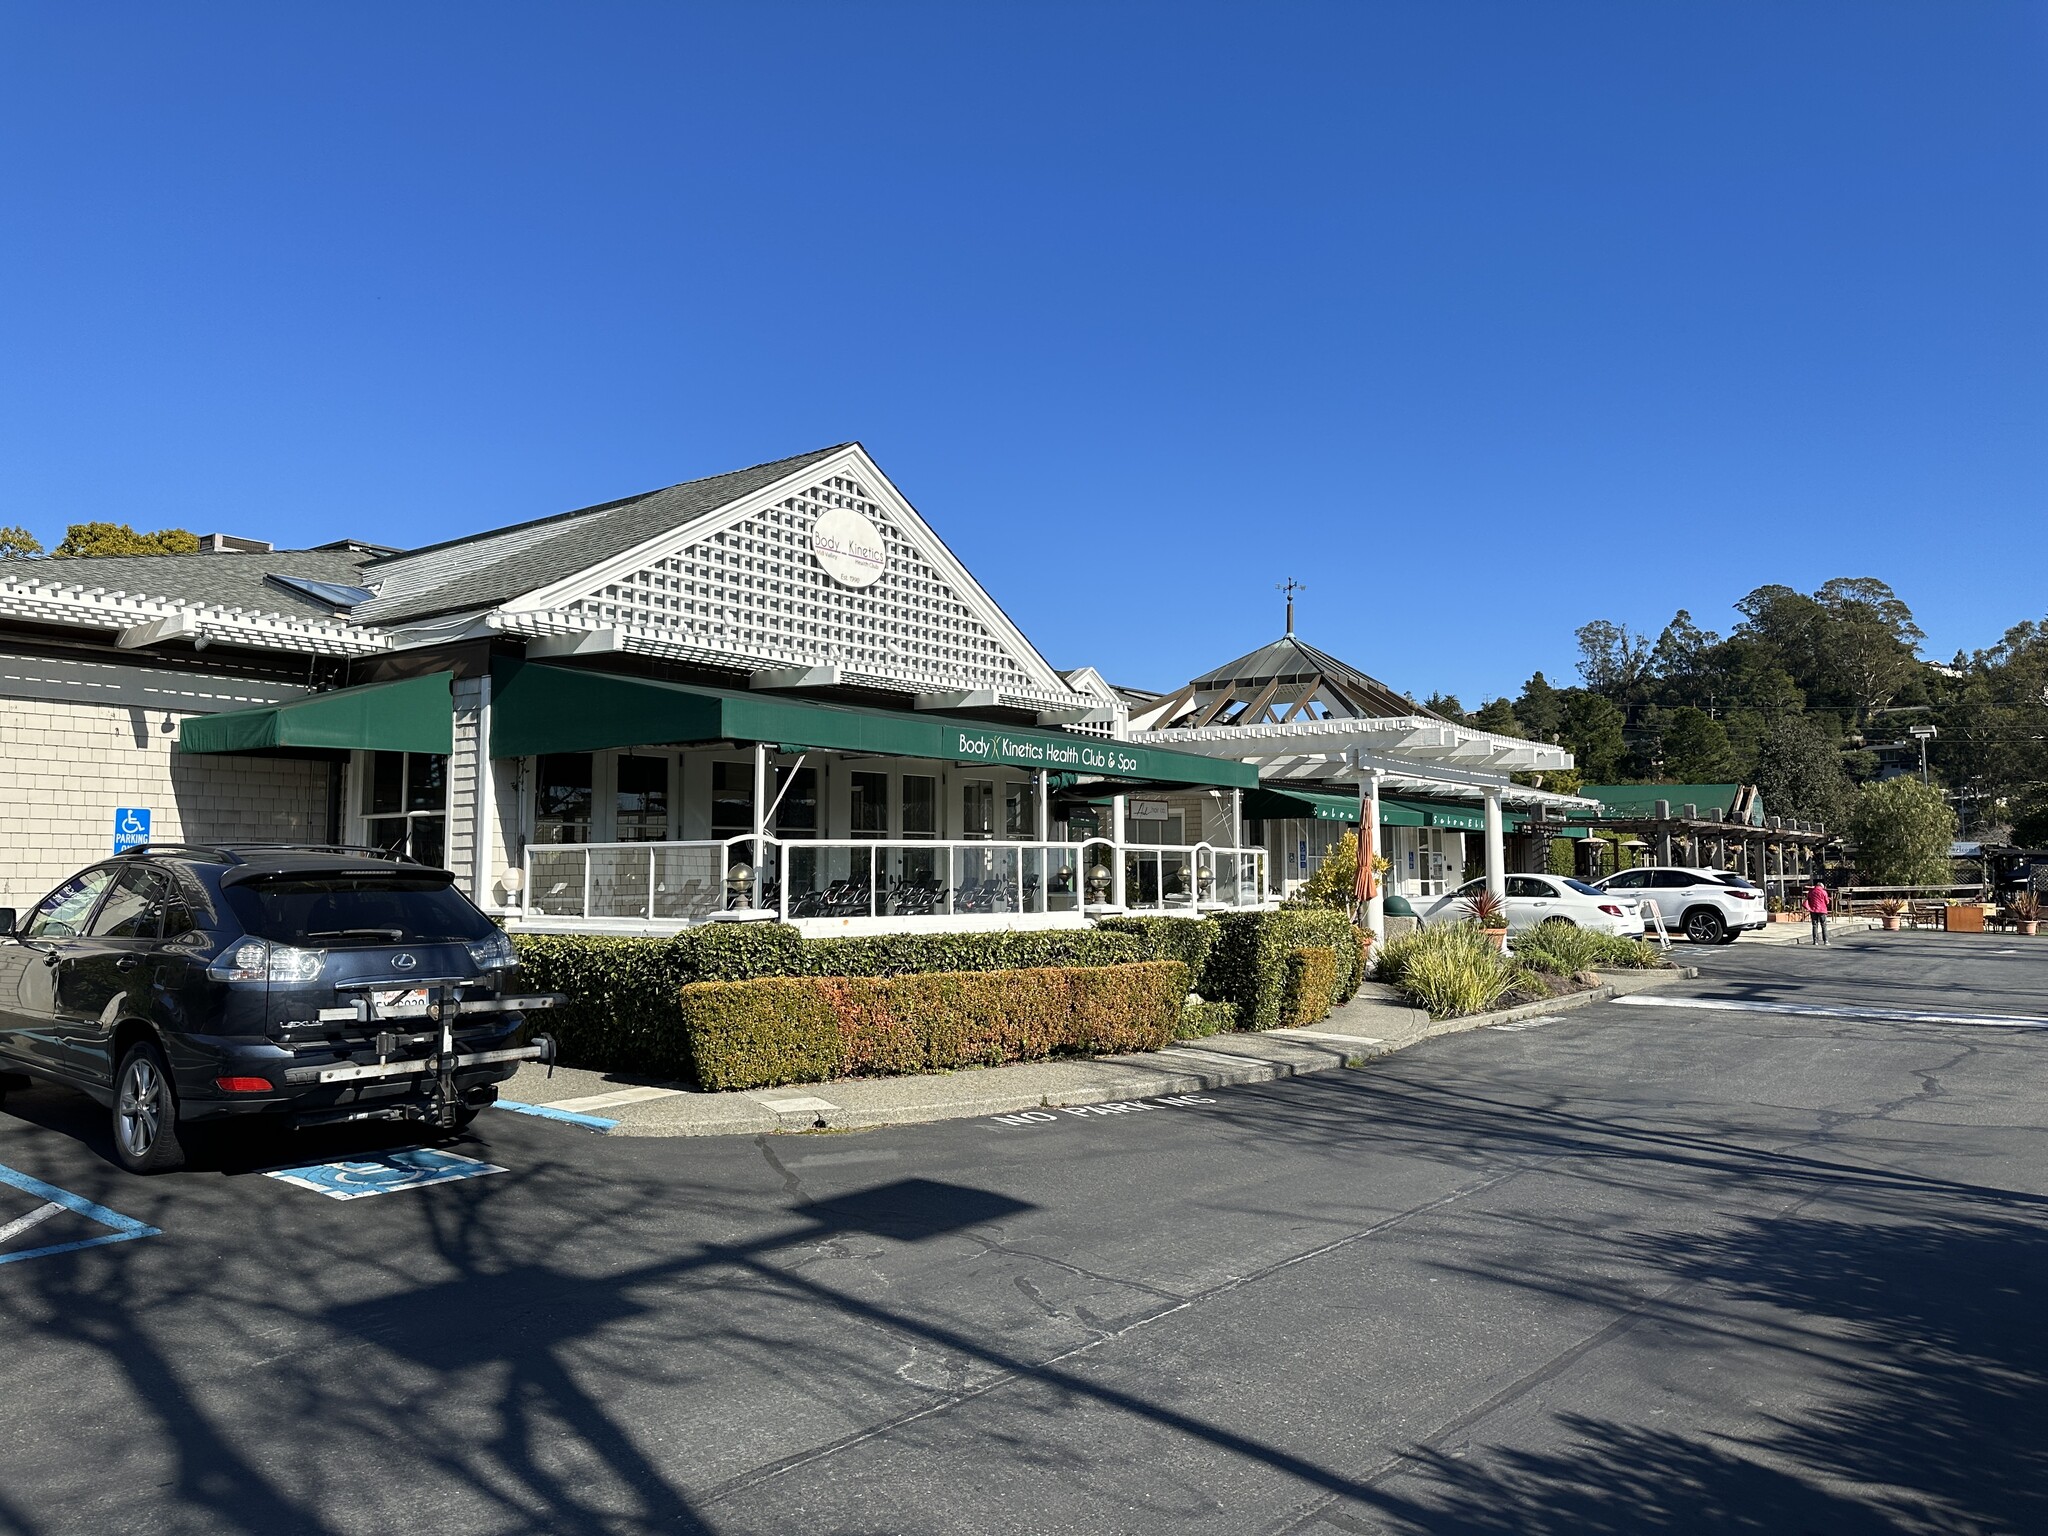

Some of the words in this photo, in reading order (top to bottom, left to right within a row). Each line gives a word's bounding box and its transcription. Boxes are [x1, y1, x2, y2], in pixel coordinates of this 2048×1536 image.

[815, 531, 840, 551] Body
[848, 540, 884, 562] Kinetics
[959, 733, 990, 758] Body
[1002, 738, 1043, 760] Kinetics
[1046, 743, 1079, 764] Health
[1081, 748, 1106, 767] Club
[1107, 751, 1116, 768] &
[1117, 753, 1137, 773] Spa
[116, 833, 149, 844] PARKING
[990, 1111, 1058, 1126] NO
[1059, 1095, 1217, 1118] PARKING
